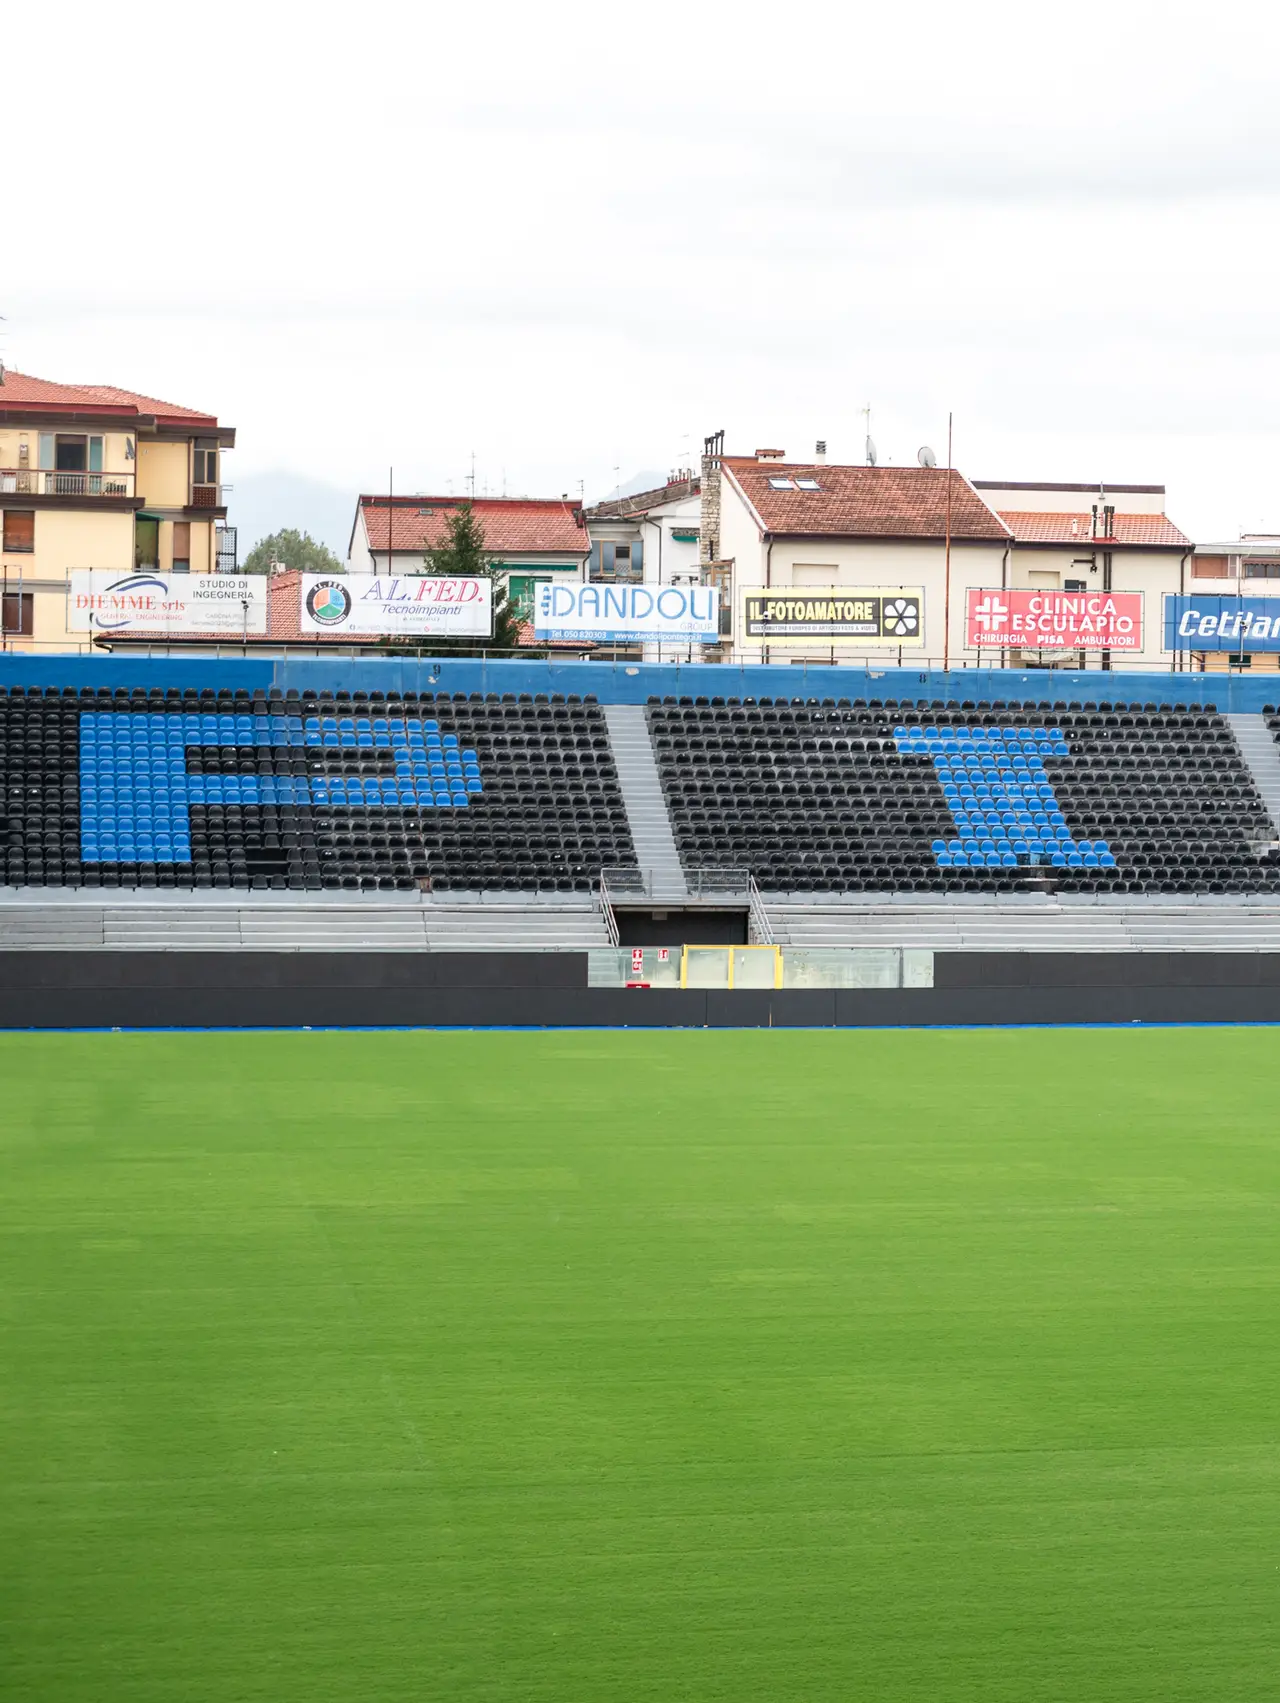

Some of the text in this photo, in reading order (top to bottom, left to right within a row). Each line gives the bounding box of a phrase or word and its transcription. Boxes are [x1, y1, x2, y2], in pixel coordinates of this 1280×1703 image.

[199, 580, 249, 589] STUDIO DI
[192, 590, 254, 600] INGEGNERIA
[76, 594, 185, 611] DIEMME srls
[552, 586, 713, 620] DANDOLI
[1029, 597, 1117, 615] CLINICA
[381, 604, 463, 616] Tecnoimpianti
[750, 601, 874, 621] IL FOTOAMATORE
[135, 613, 183, 621] ENGINEERING
[680, 622, 713, 631] GROUP
[1013, 614, 1133, 633] ESCULAPIO
[579, 631, 607, 639] 820303
[973, 633, 1135, 645] CHIRURGIA PISA AMBULATORI
[433, 664, 441, 675] 9
